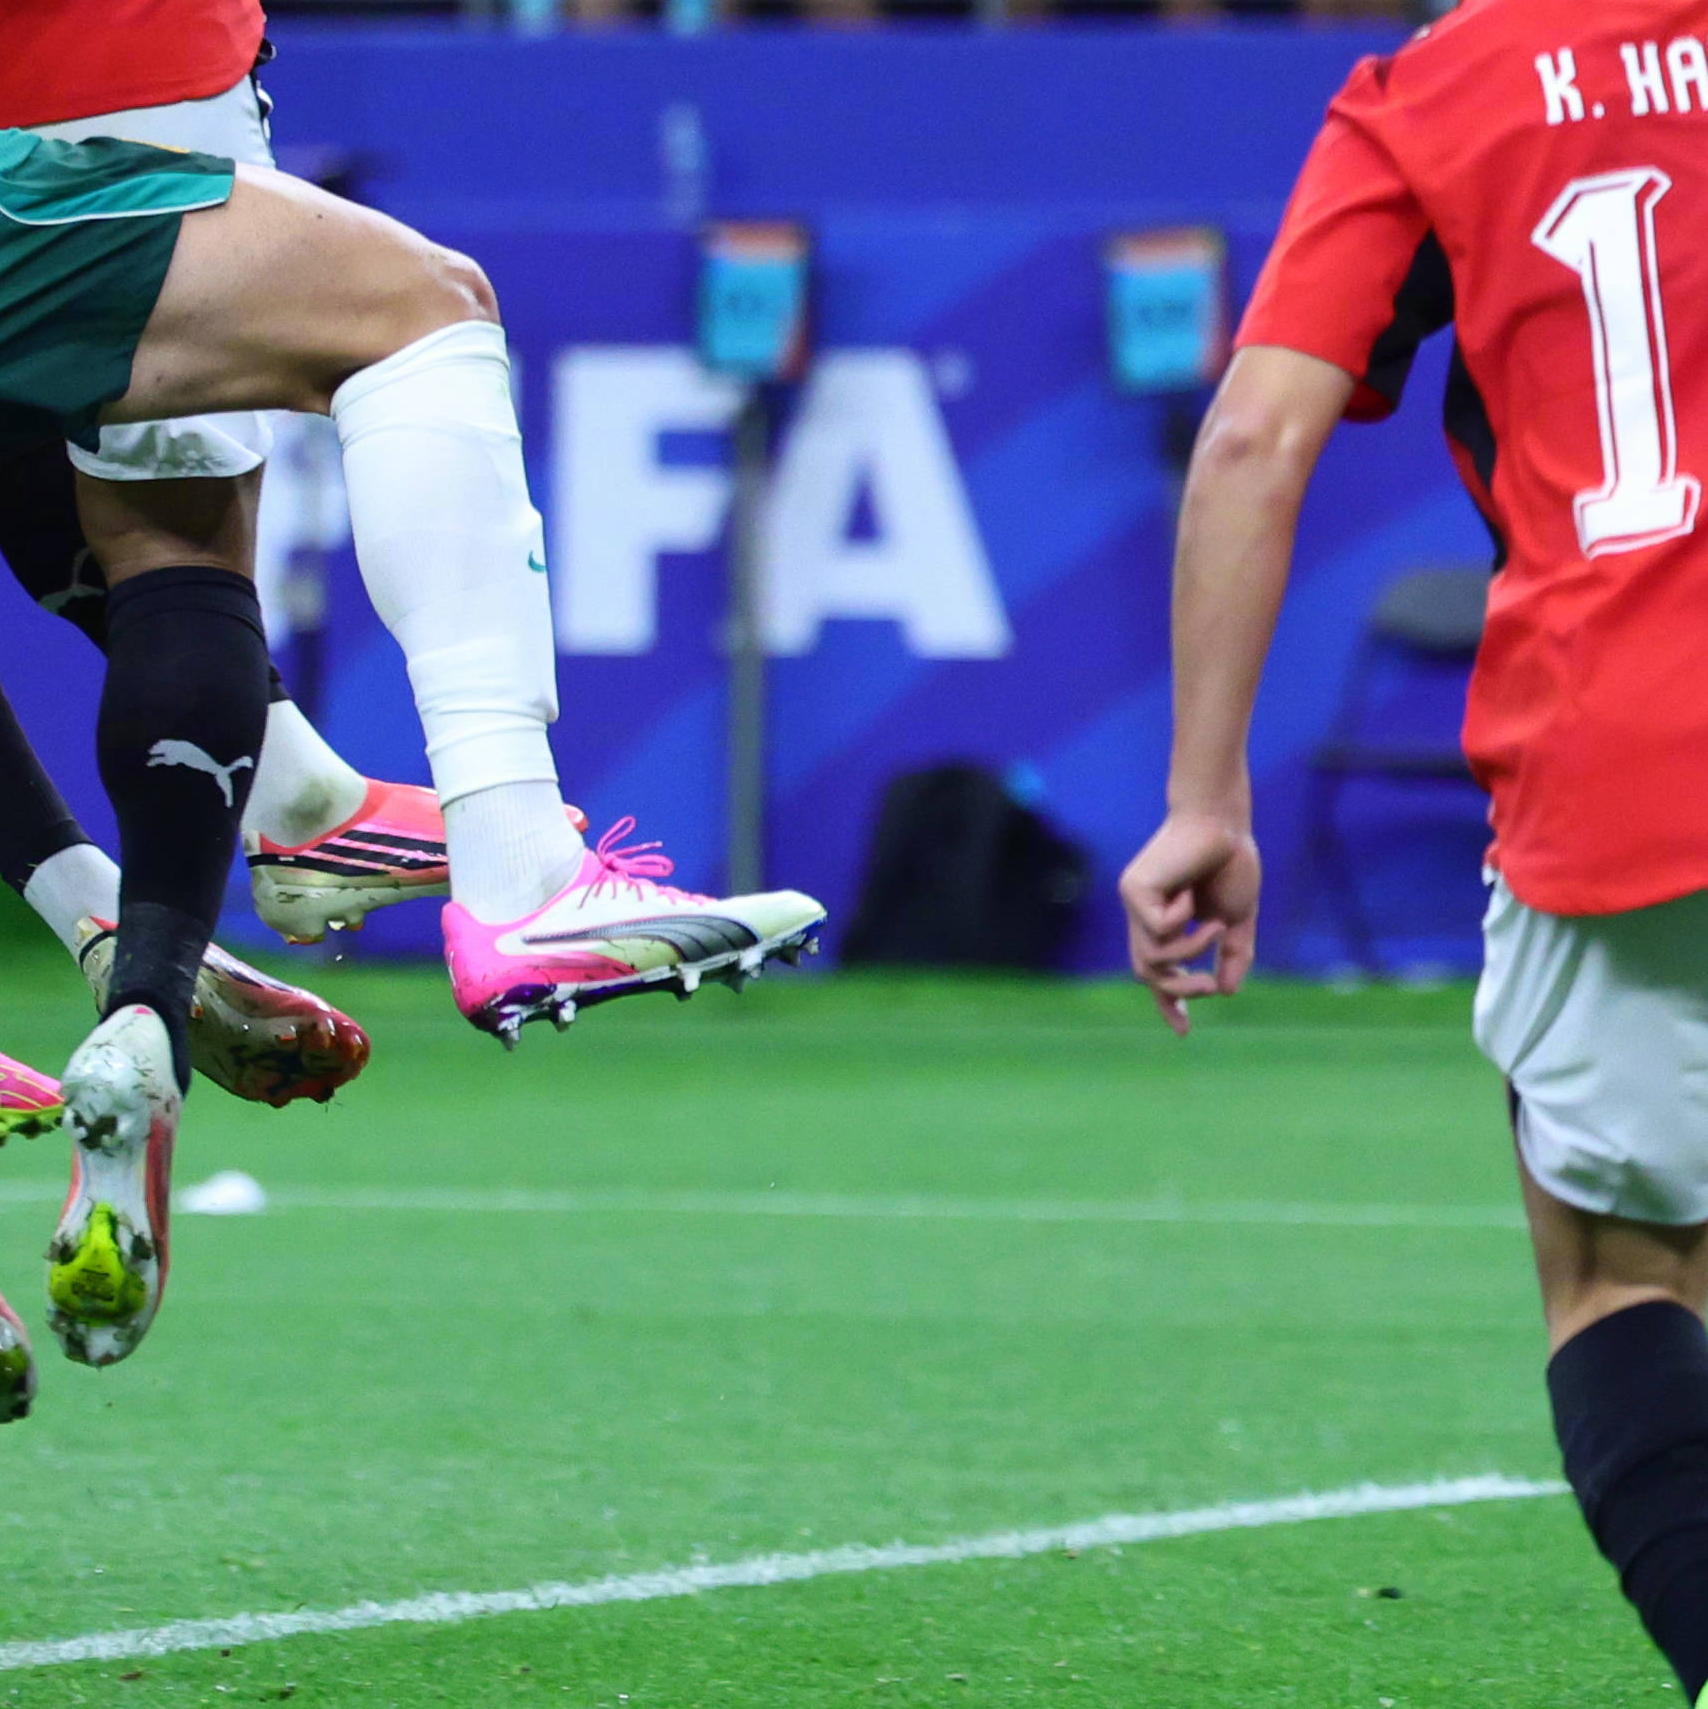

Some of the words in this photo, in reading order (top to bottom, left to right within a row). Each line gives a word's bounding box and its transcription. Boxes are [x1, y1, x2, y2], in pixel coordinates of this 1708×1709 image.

[1535, 47, 1606, 126] K.
[1620, 34, 1708, 117] HA
[1531, 165, 1701, 559] 1
